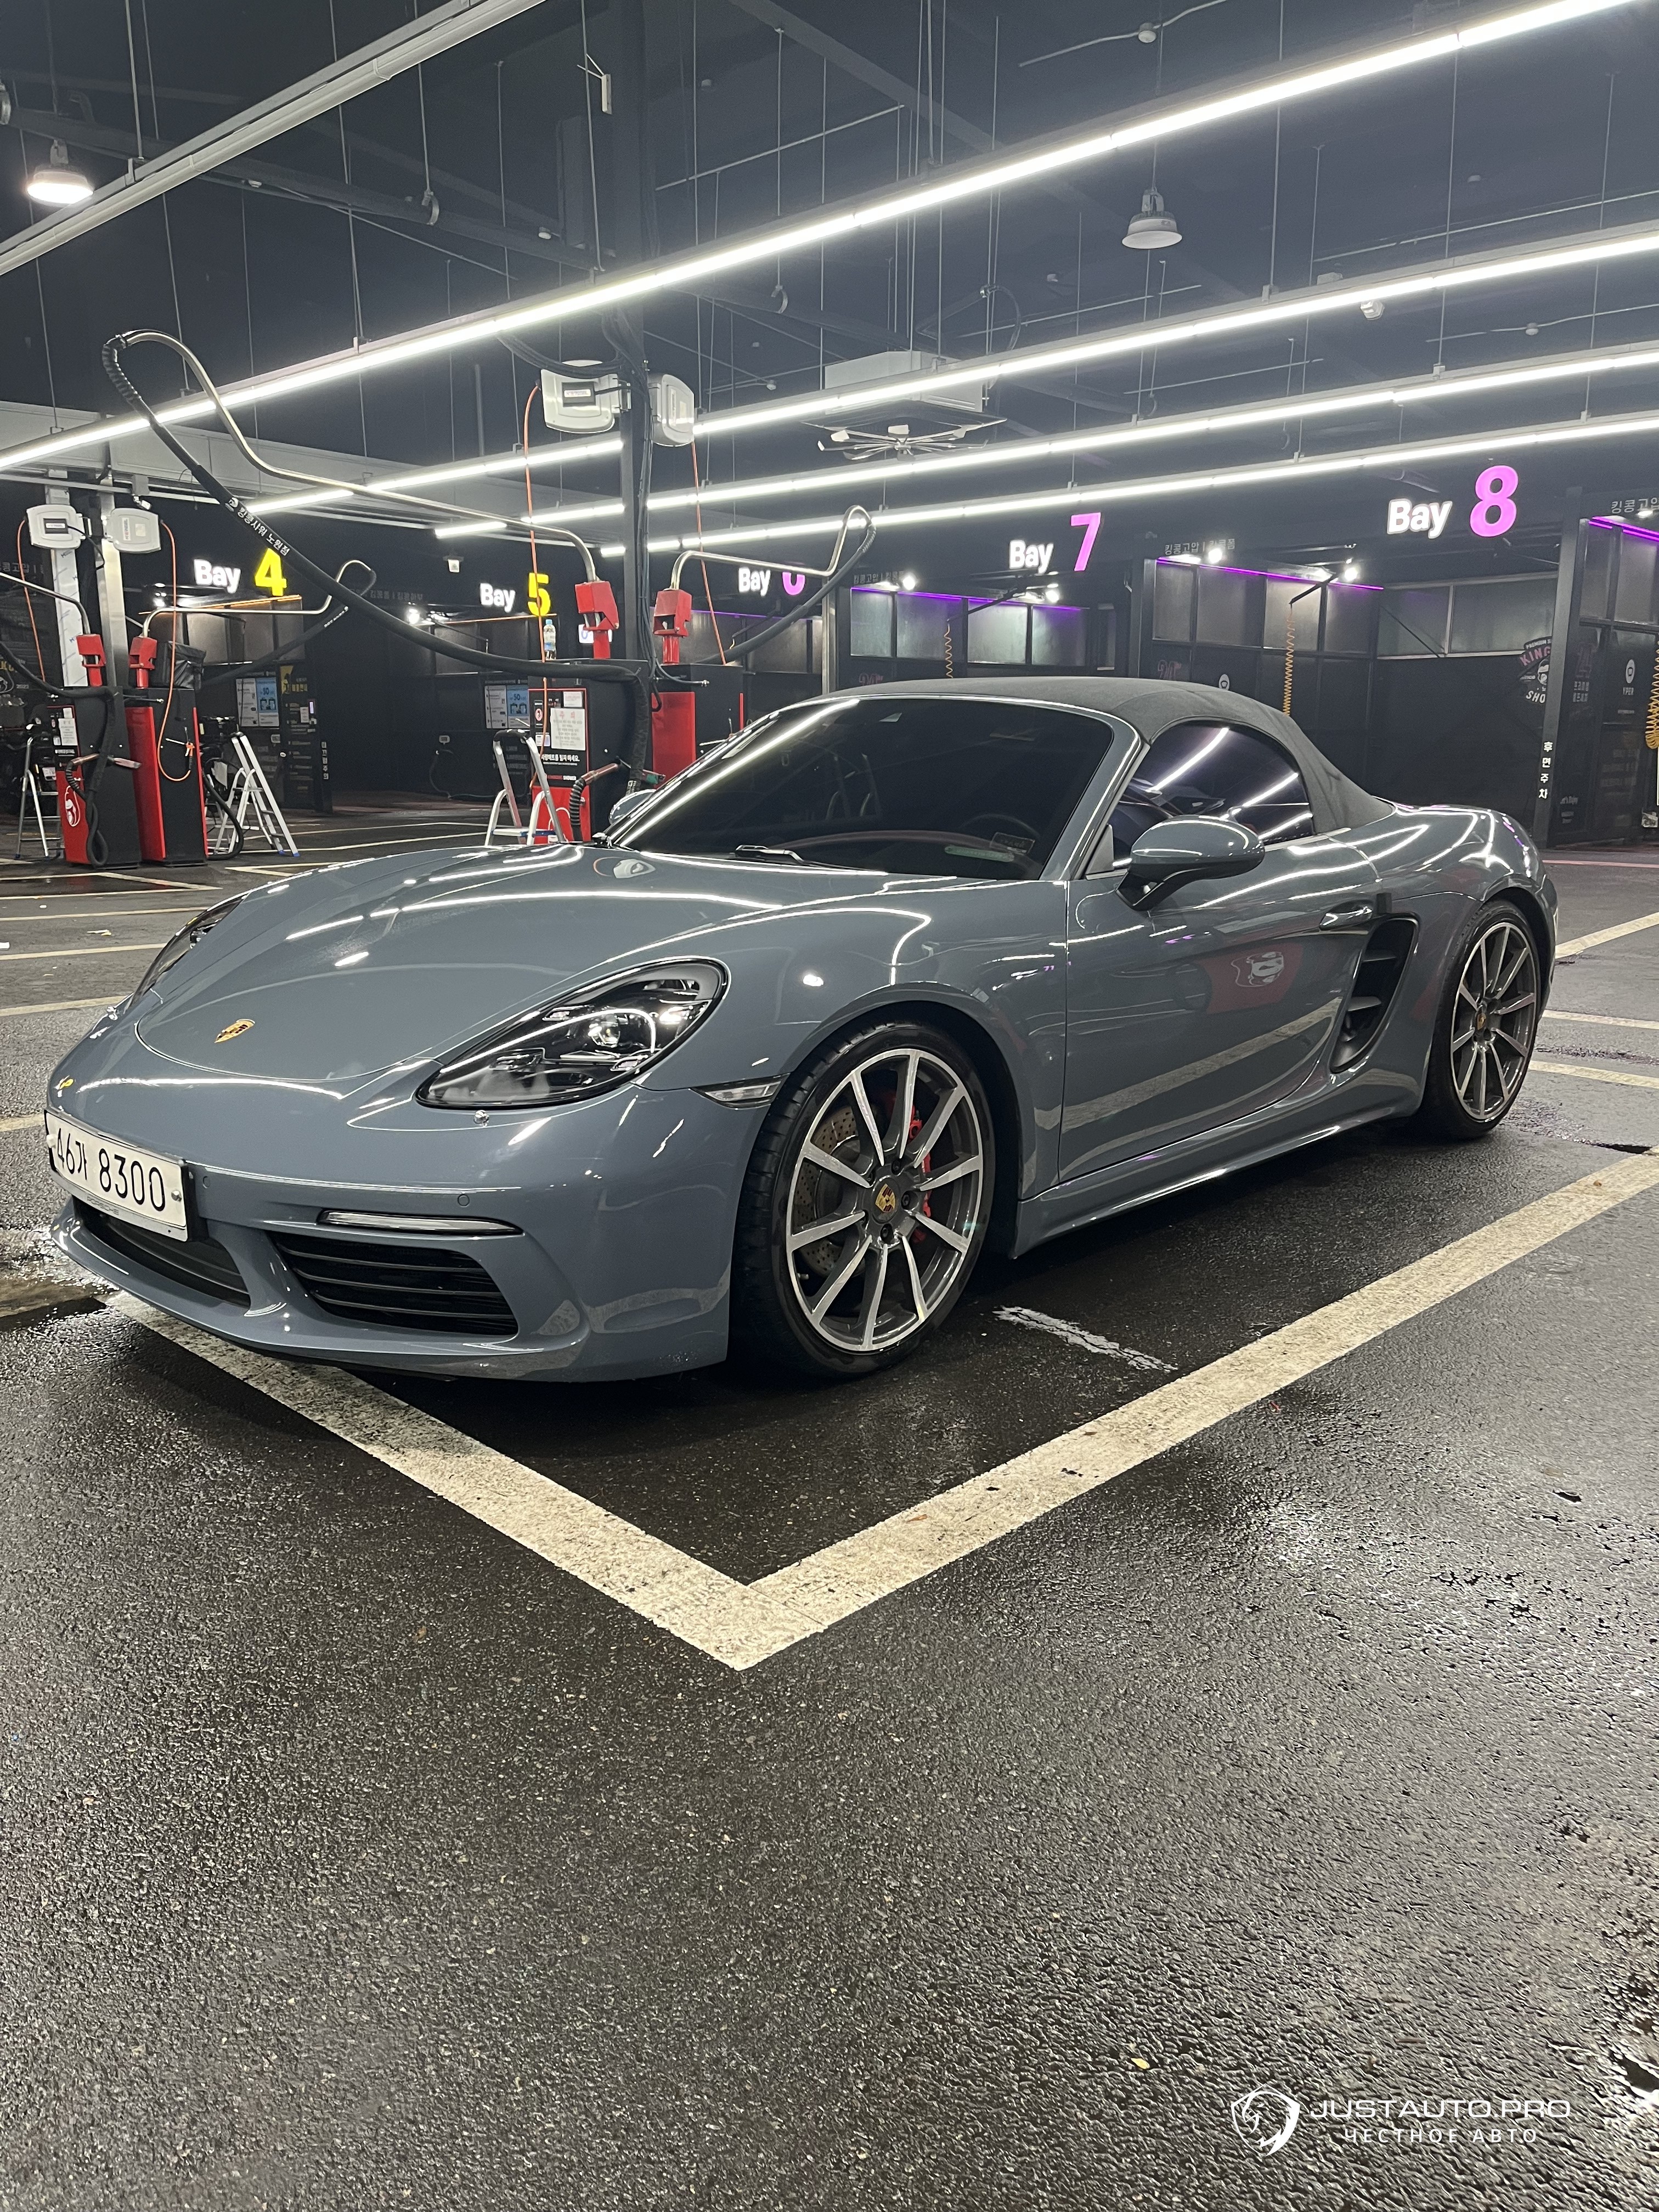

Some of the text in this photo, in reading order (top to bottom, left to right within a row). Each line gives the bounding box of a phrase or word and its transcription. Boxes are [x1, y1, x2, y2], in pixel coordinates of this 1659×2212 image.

[1387, 465, 1519, 539] Bay 8
[238, 507, 290, 556] 킹콩샤워 노원점
[1009, 512, 1101, 574] Bay 7
[1165, 542, 1199, 555] 킹콩고압
[194, 548, 287, 596] Bay 4
[480, 572, 551, 616] Bay 5
[738, 566, 771, 596] Bay
[1538, 742, 1553, 799] 후면주차
[57, 1127, 165, 1211] 46가 8300
[87, 1195, 120, 1216] PORSCHE
